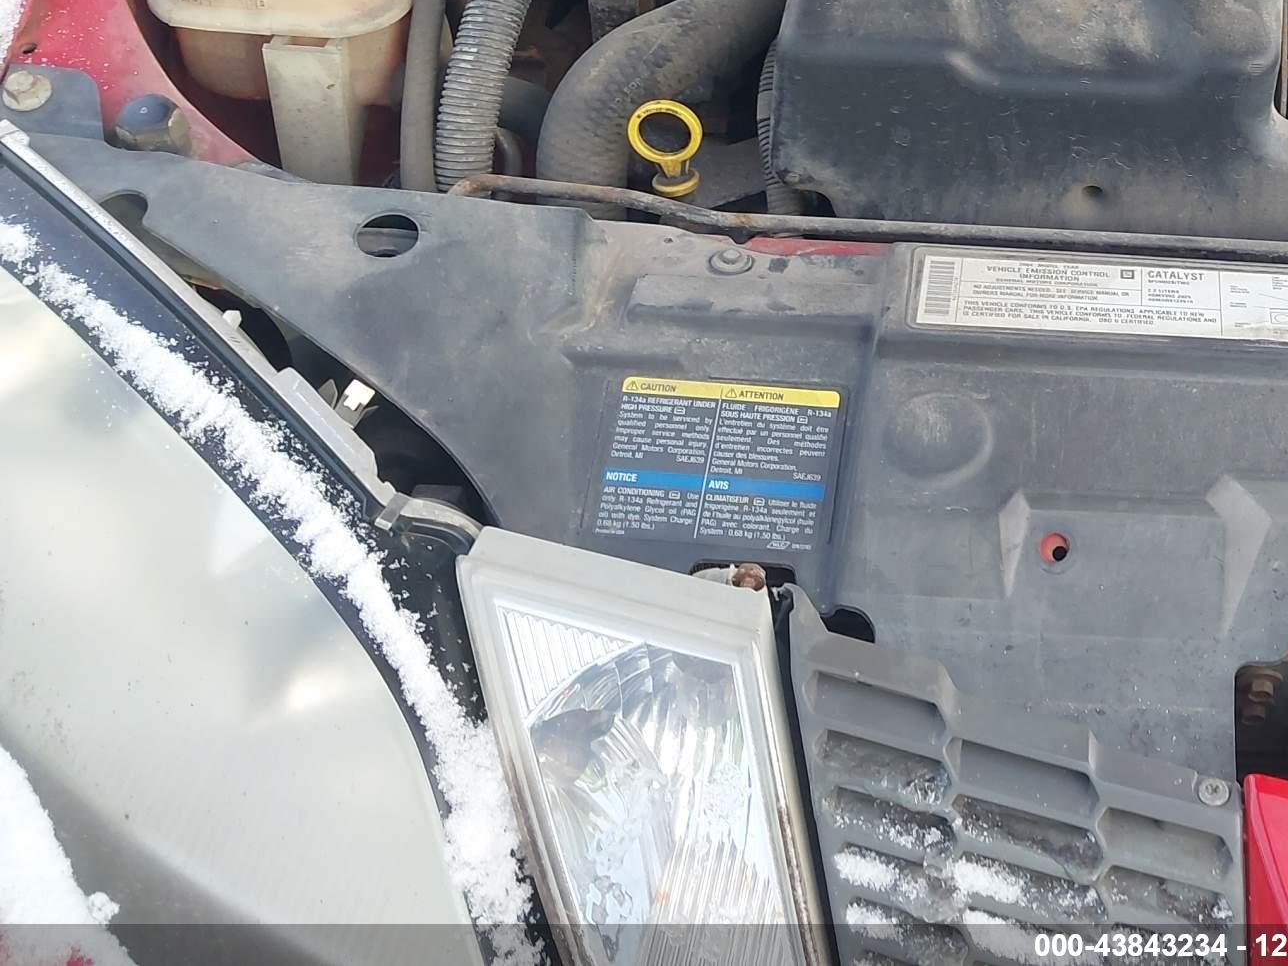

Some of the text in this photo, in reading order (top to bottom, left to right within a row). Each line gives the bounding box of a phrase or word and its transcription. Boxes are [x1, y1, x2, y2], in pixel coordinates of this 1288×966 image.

[1147, 270, 1204, 280] CATALYST
[640, 383, 676, 392] CAUTION
[738, 390, 784, 400] ATTENTION
[622, 395, 715, 408] R-134a REFRIGERANT UNDER
[620, 402, 673, 413] HIGH PRESSURE
[721, 402, 831, 417] FLUIDE FRIGORIGÈNE R-134a
[618, 410, 644, 419] System
[719, 410, 738, 418] SOUS
[762, 413, 795, 422] PRESSION
[654, 421, 687, 430] personnel
[718, 419, 752, 427] L'entretien
[615, 427, 645, 435] Improper
[771, 431, 802, 439] personnel
[632, 436, 651, 444] cause
[655, 438, 684, 446] personal
[612, 442, 637, 450] General
[640, 444, 663, 452] Motors
[711, 458, 735, 466] General
[736, 460, 758, 468] Motors
[605, 472, 638, 481] NOTICE
[708, 479, 729, 489] AVIS
[616, 487, 665, 497] CONDITIONING
[704, 494, 749, 503] CLIMATISEUR
[743, 505, 767, 514] R-134a
[642, 514, 667, 522] System
[776, 524, 799, 532] Charge
